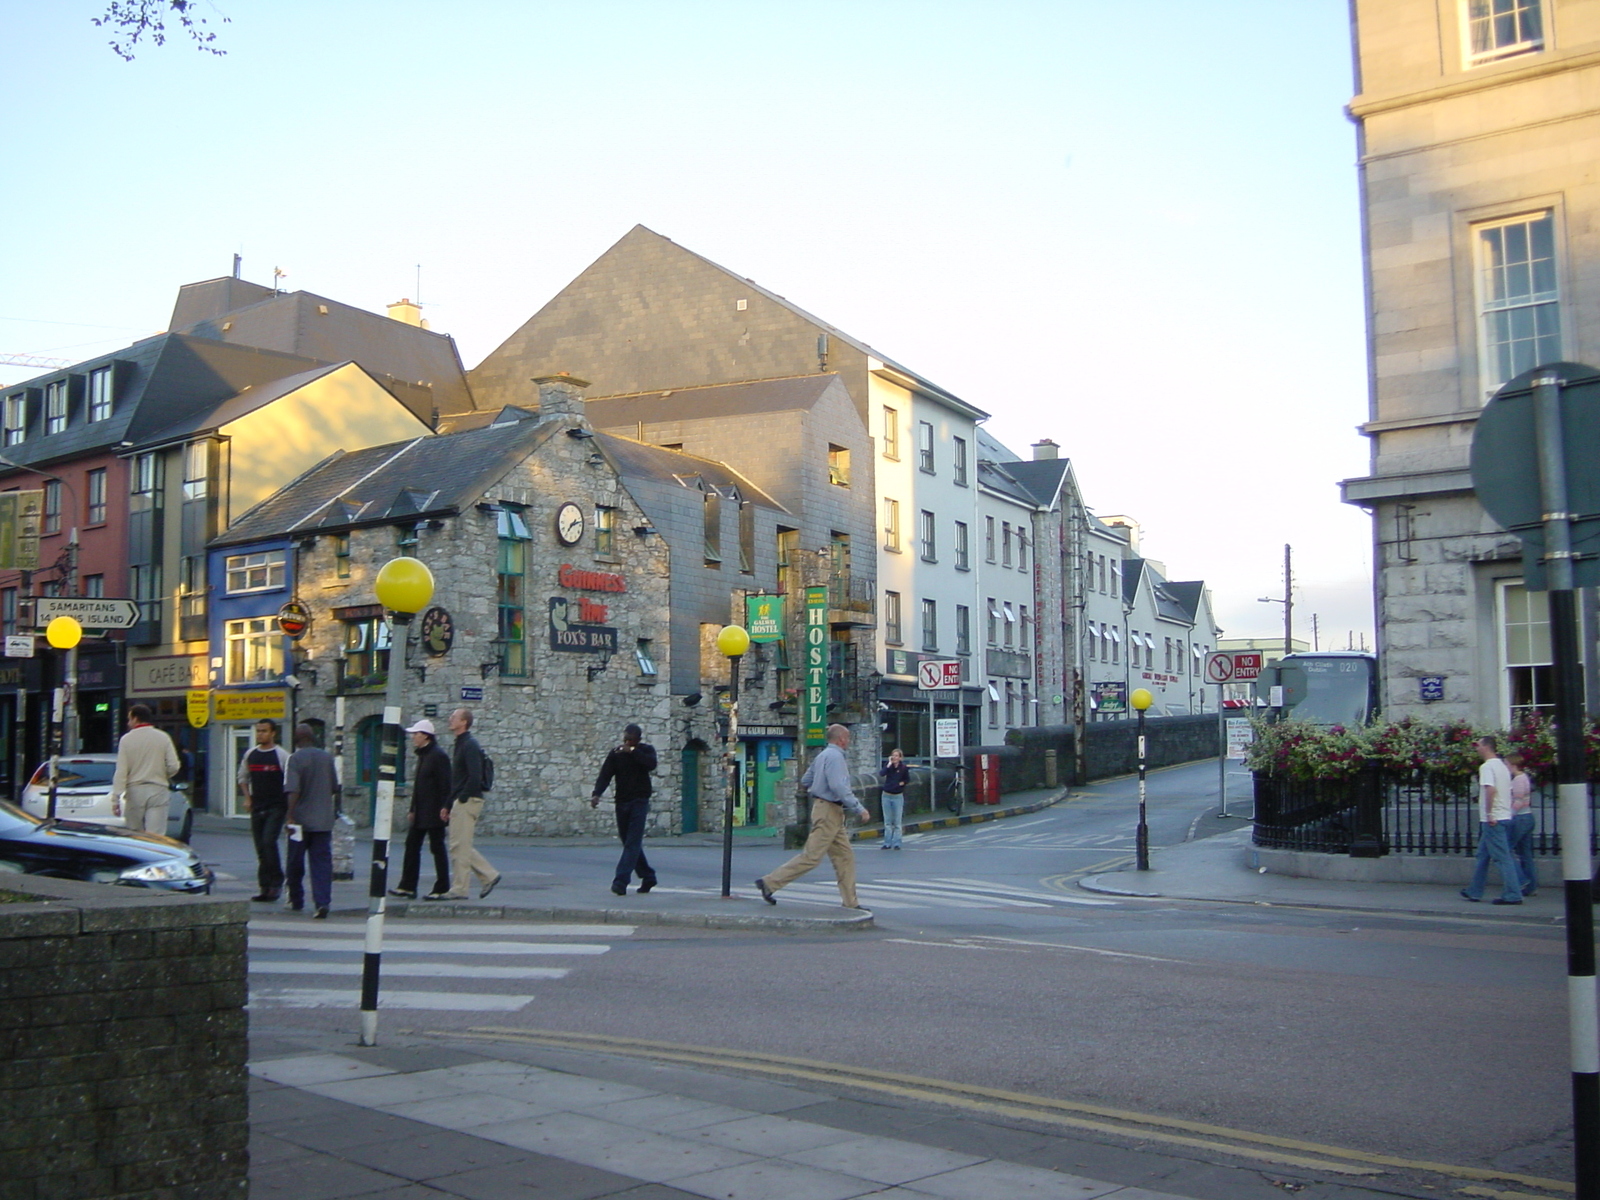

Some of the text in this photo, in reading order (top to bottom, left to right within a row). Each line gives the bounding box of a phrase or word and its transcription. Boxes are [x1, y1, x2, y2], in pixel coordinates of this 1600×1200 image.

[558, 563, 627, 593] GUINNESS
[50, 602, 116, 612] SAMARITANS
[578, 597, 609, 624] TIME
[40, 614, 51, 622] 14
[88, 615, 124, 624] ISLAND
[751, 625, 779, 634] HOSTEL
[557, 630, 612, 647] FOX'S BAR
[808, 608, 824, 723] HOSTEL
[1241, 657, 1254, 666] NO
[149, 663, 201, 684] CAFÉ BAR
[1236, 667, 1260, 677] ENTRY
